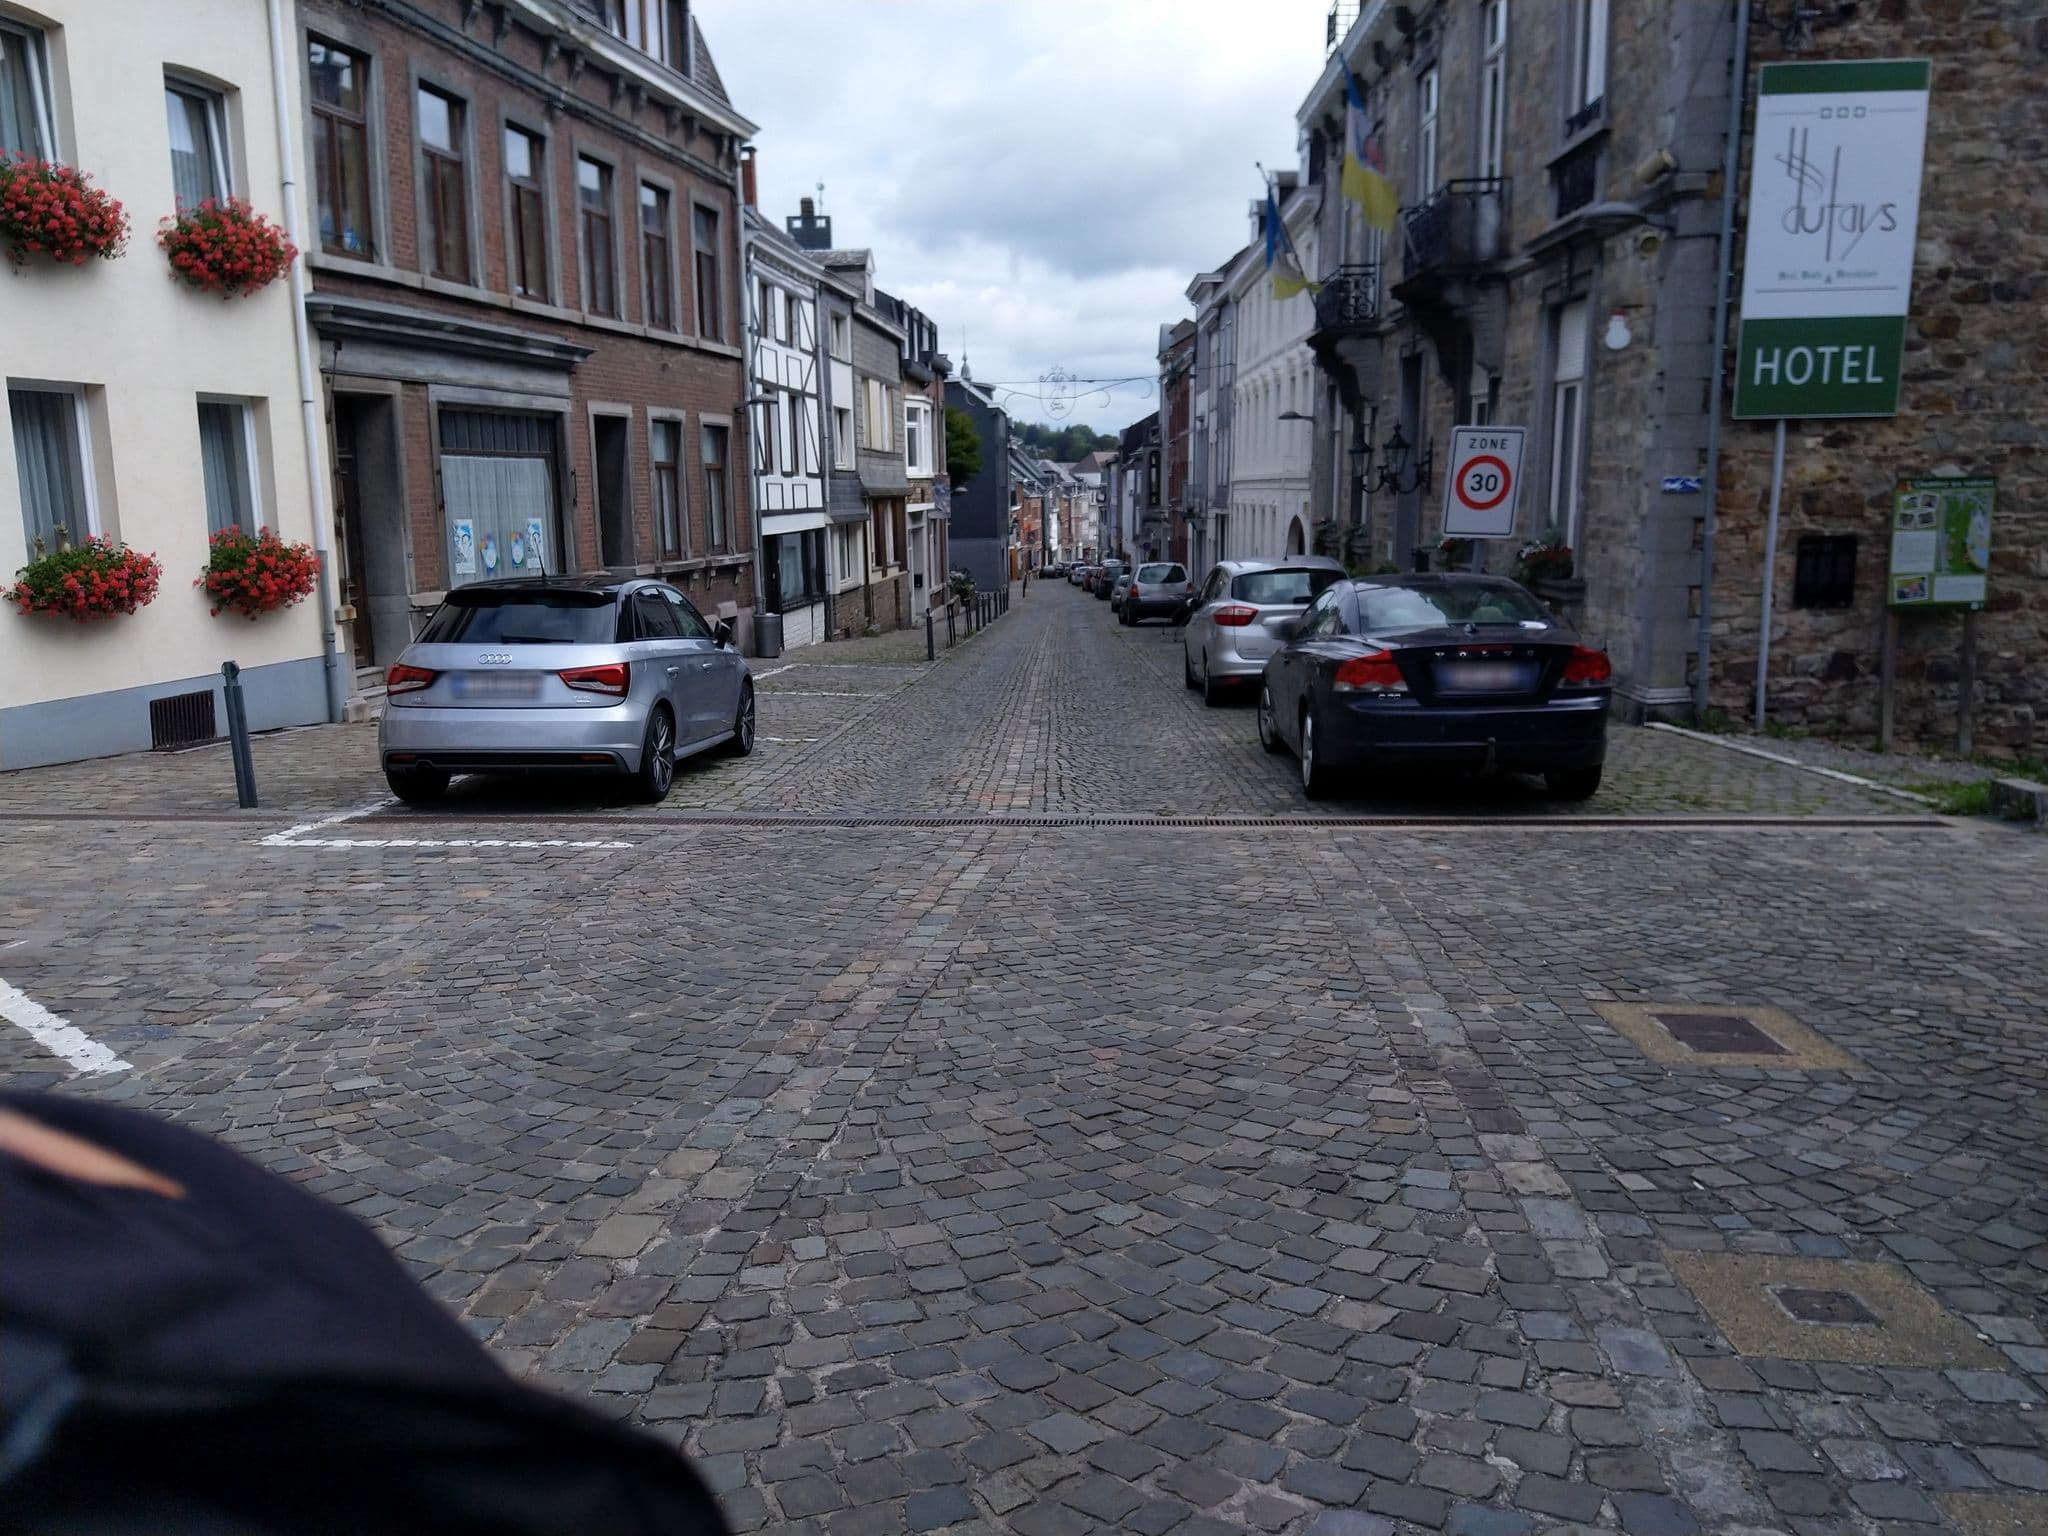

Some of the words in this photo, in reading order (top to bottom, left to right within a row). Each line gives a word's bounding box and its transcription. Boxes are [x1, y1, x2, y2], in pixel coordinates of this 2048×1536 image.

[1753, 345, 1884, 386] HOTEL
[1469, 438, 1508, 450] ZONE
[1470, 473, 1498, 492] 30
